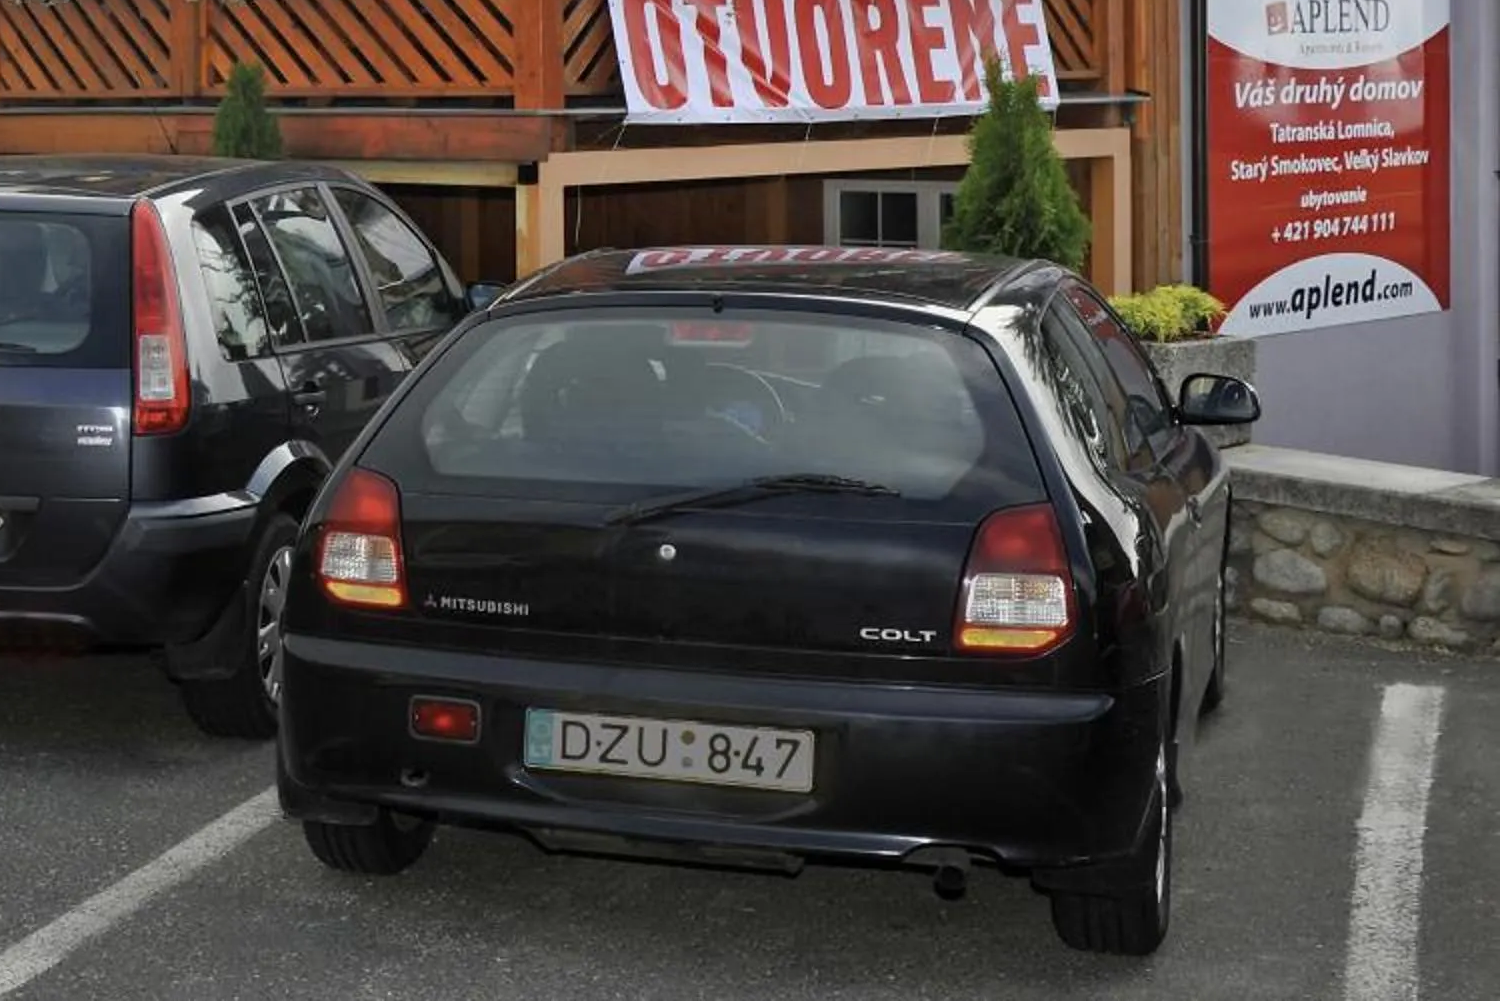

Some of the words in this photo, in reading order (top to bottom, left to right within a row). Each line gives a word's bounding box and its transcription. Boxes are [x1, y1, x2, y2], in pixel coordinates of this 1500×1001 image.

[1234, 78, 1276, 108] Váš
[1279, 76, 1345, 110] druhý
[1349, 74, 1424, 101] domov
[1269, 120, 1335, 143] Tatranská
[1338, 118, 1395, 139] Lomnica,
[1231, 155, 1268, 183] Starý
[1271, 152, 1343, 176] Smokovec,
[1381, 146, 1429, 168] Slavkov
[1300, 186, 1367, 210] ubytovanie
[1313, 217, 1340, 239] 904
[1342, 214, 1369, 236] 744
[1372, 211, 1396, 232] 111
[1250, 268, 1413, 319] www.aplend.com
[440, 596, 529, 616] MITSUBISHI
[860, 627, 937, 642] COLT
[560, 720, 668, 768] DZU
[707, 732, 801, 779] 847
